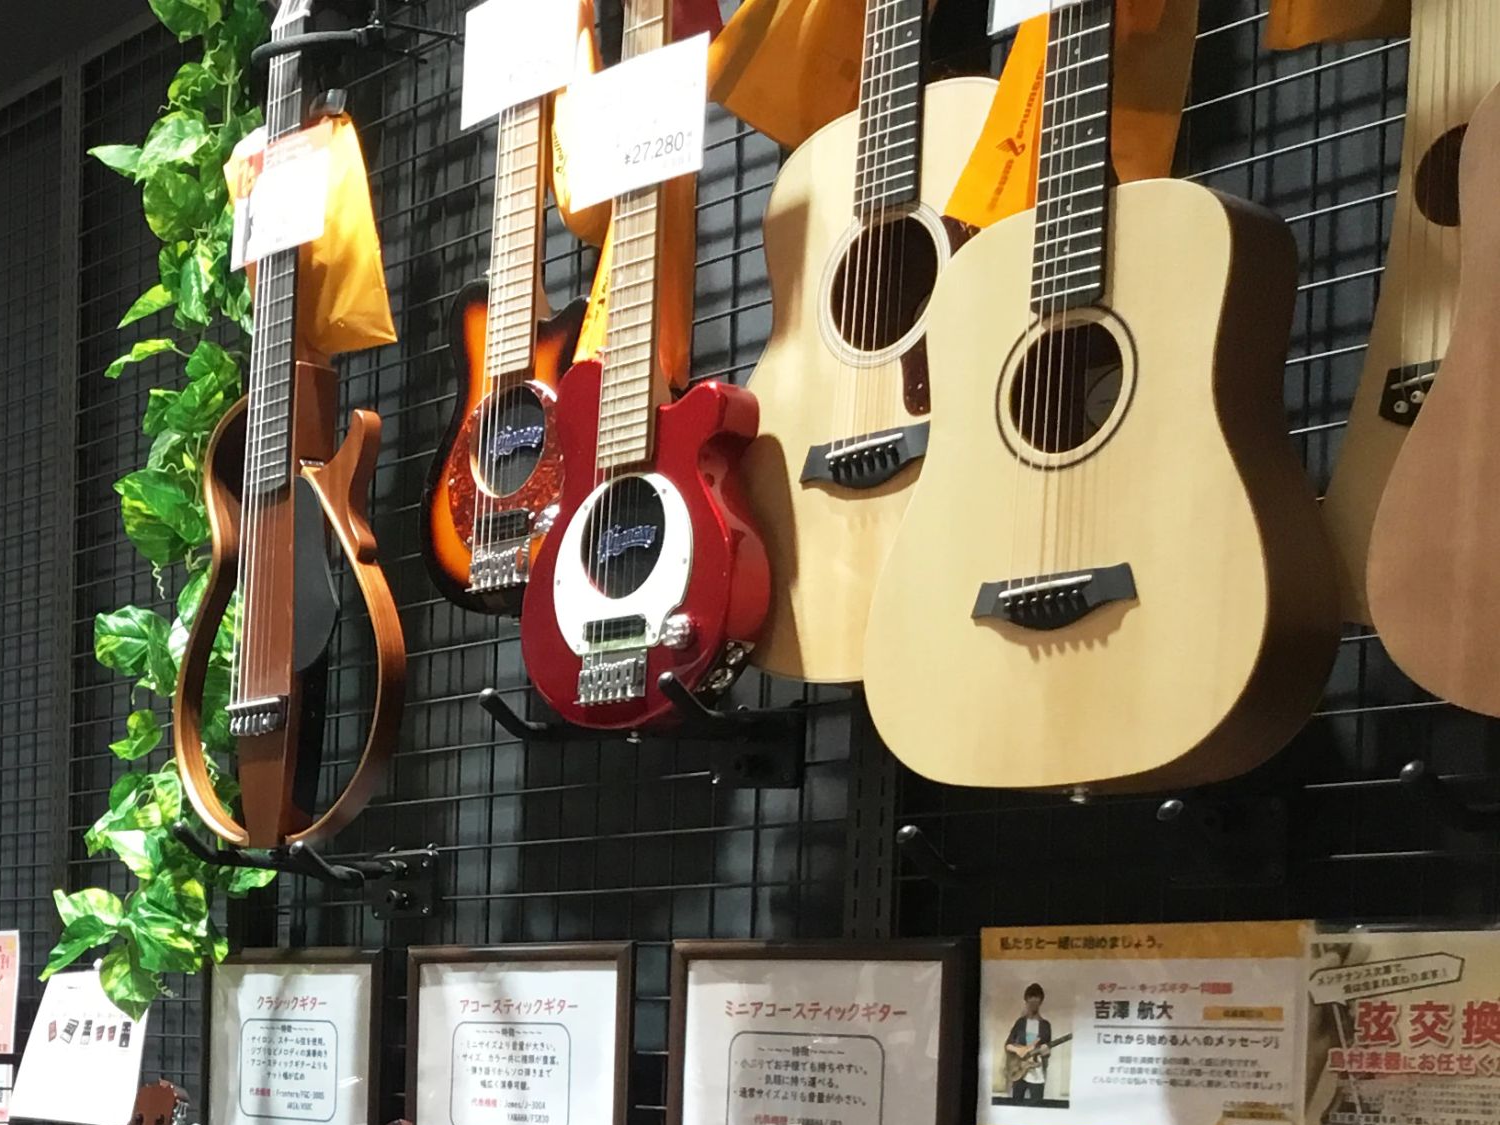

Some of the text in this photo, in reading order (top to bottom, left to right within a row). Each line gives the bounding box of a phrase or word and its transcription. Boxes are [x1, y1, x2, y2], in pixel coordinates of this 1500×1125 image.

[257, 995, 328, 1012] クラシックギター
[459, 998, 579, 1016] アコースティックギター
[724, 1000, 908, 1022] ミニアコースティックギター
